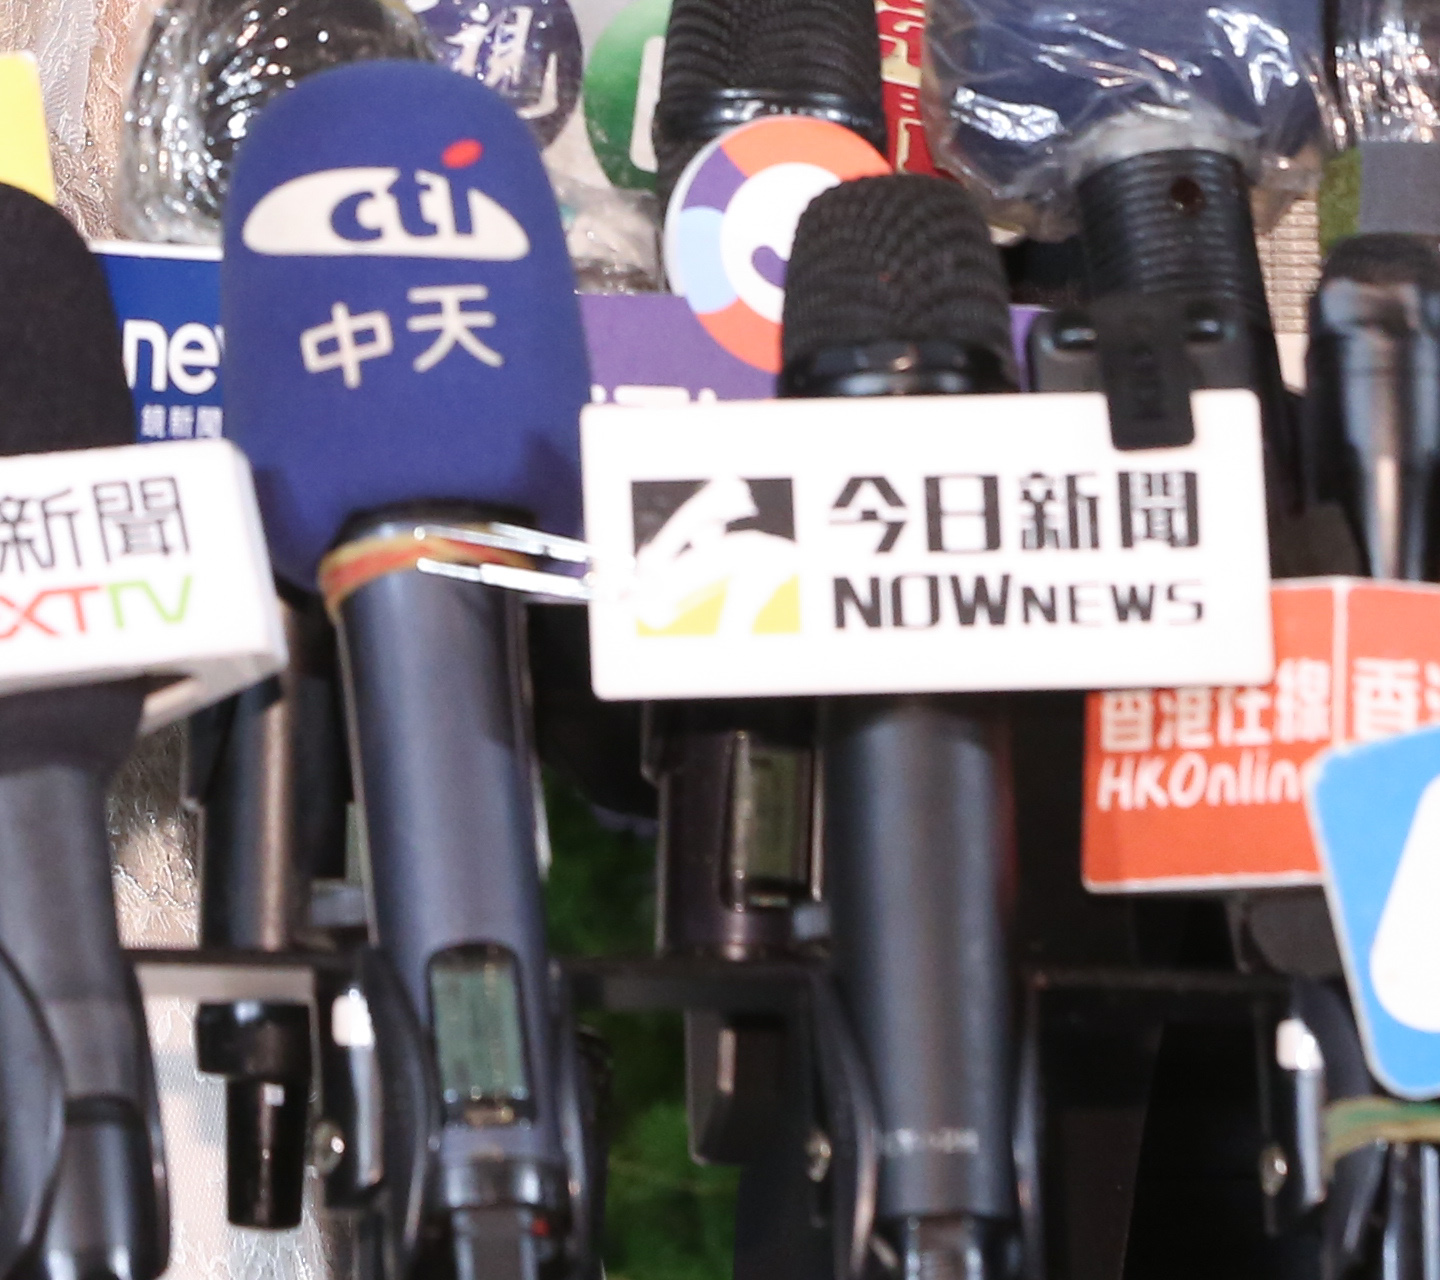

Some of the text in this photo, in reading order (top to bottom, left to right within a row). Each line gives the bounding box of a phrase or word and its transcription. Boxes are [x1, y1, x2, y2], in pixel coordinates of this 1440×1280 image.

[299, 283, 504, 390] 中天
[828, 470, 1201, 554] 今日新聞
[1096, 746, 1312, 812] HKOnlin
